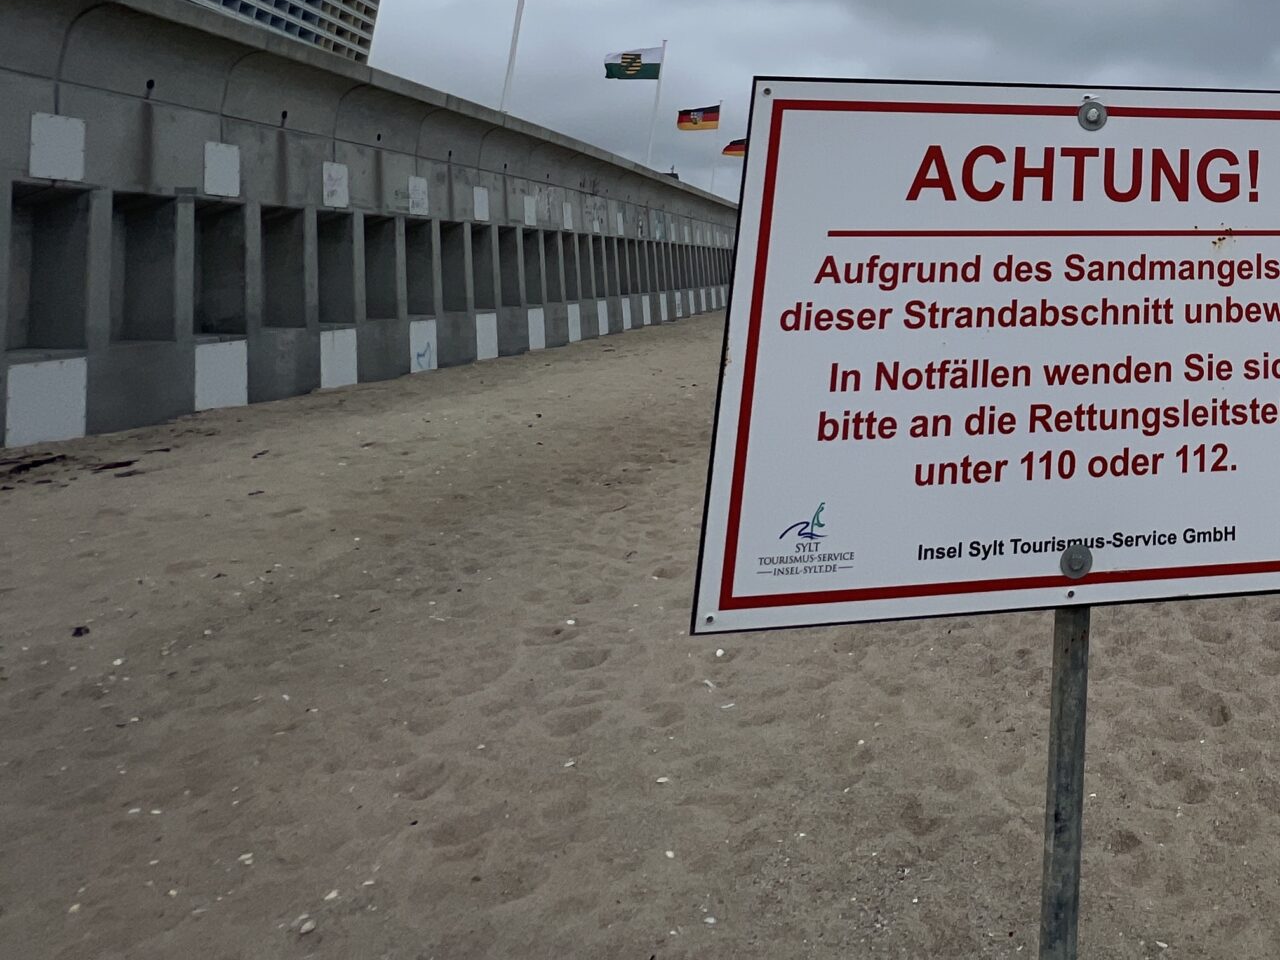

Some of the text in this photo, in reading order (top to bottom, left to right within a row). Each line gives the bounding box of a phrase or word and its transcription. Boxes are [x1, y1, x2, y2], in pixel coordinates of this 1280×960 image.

[907, 145, 1259, 202] ACHTUNG!
[815, 256, 981, 291] Aufgrund
[994, 256, 1051, 282] des
[1065, 254, 1280, 288] Sandmangels
[780, 303, 891, 331] dieser
[904, 298, 1173, 329] Strandabschnitt
[830, 363, 860, 392] In
[875, 359, 1031, 390] Notfällen
[1044, 356, 1172, 385] wenden
[1184, 354, 1233, 381] Sie
[818, 412, 897, 441] bitte
[911, 415, 951, 437] an
[965, 408, 1017, 435] die
[915, 443, 1238, 486] unter 110 oder 112.
[758, 551, 855, 566] TOURISMUS-SERVICE
[795, 542, 821, 553] SYLT
[917, 526, 1236, 561] Insel Sylt Tourismus-Service GmbH
[773, 564, 838, 576] INSEL-SYLT.DE
